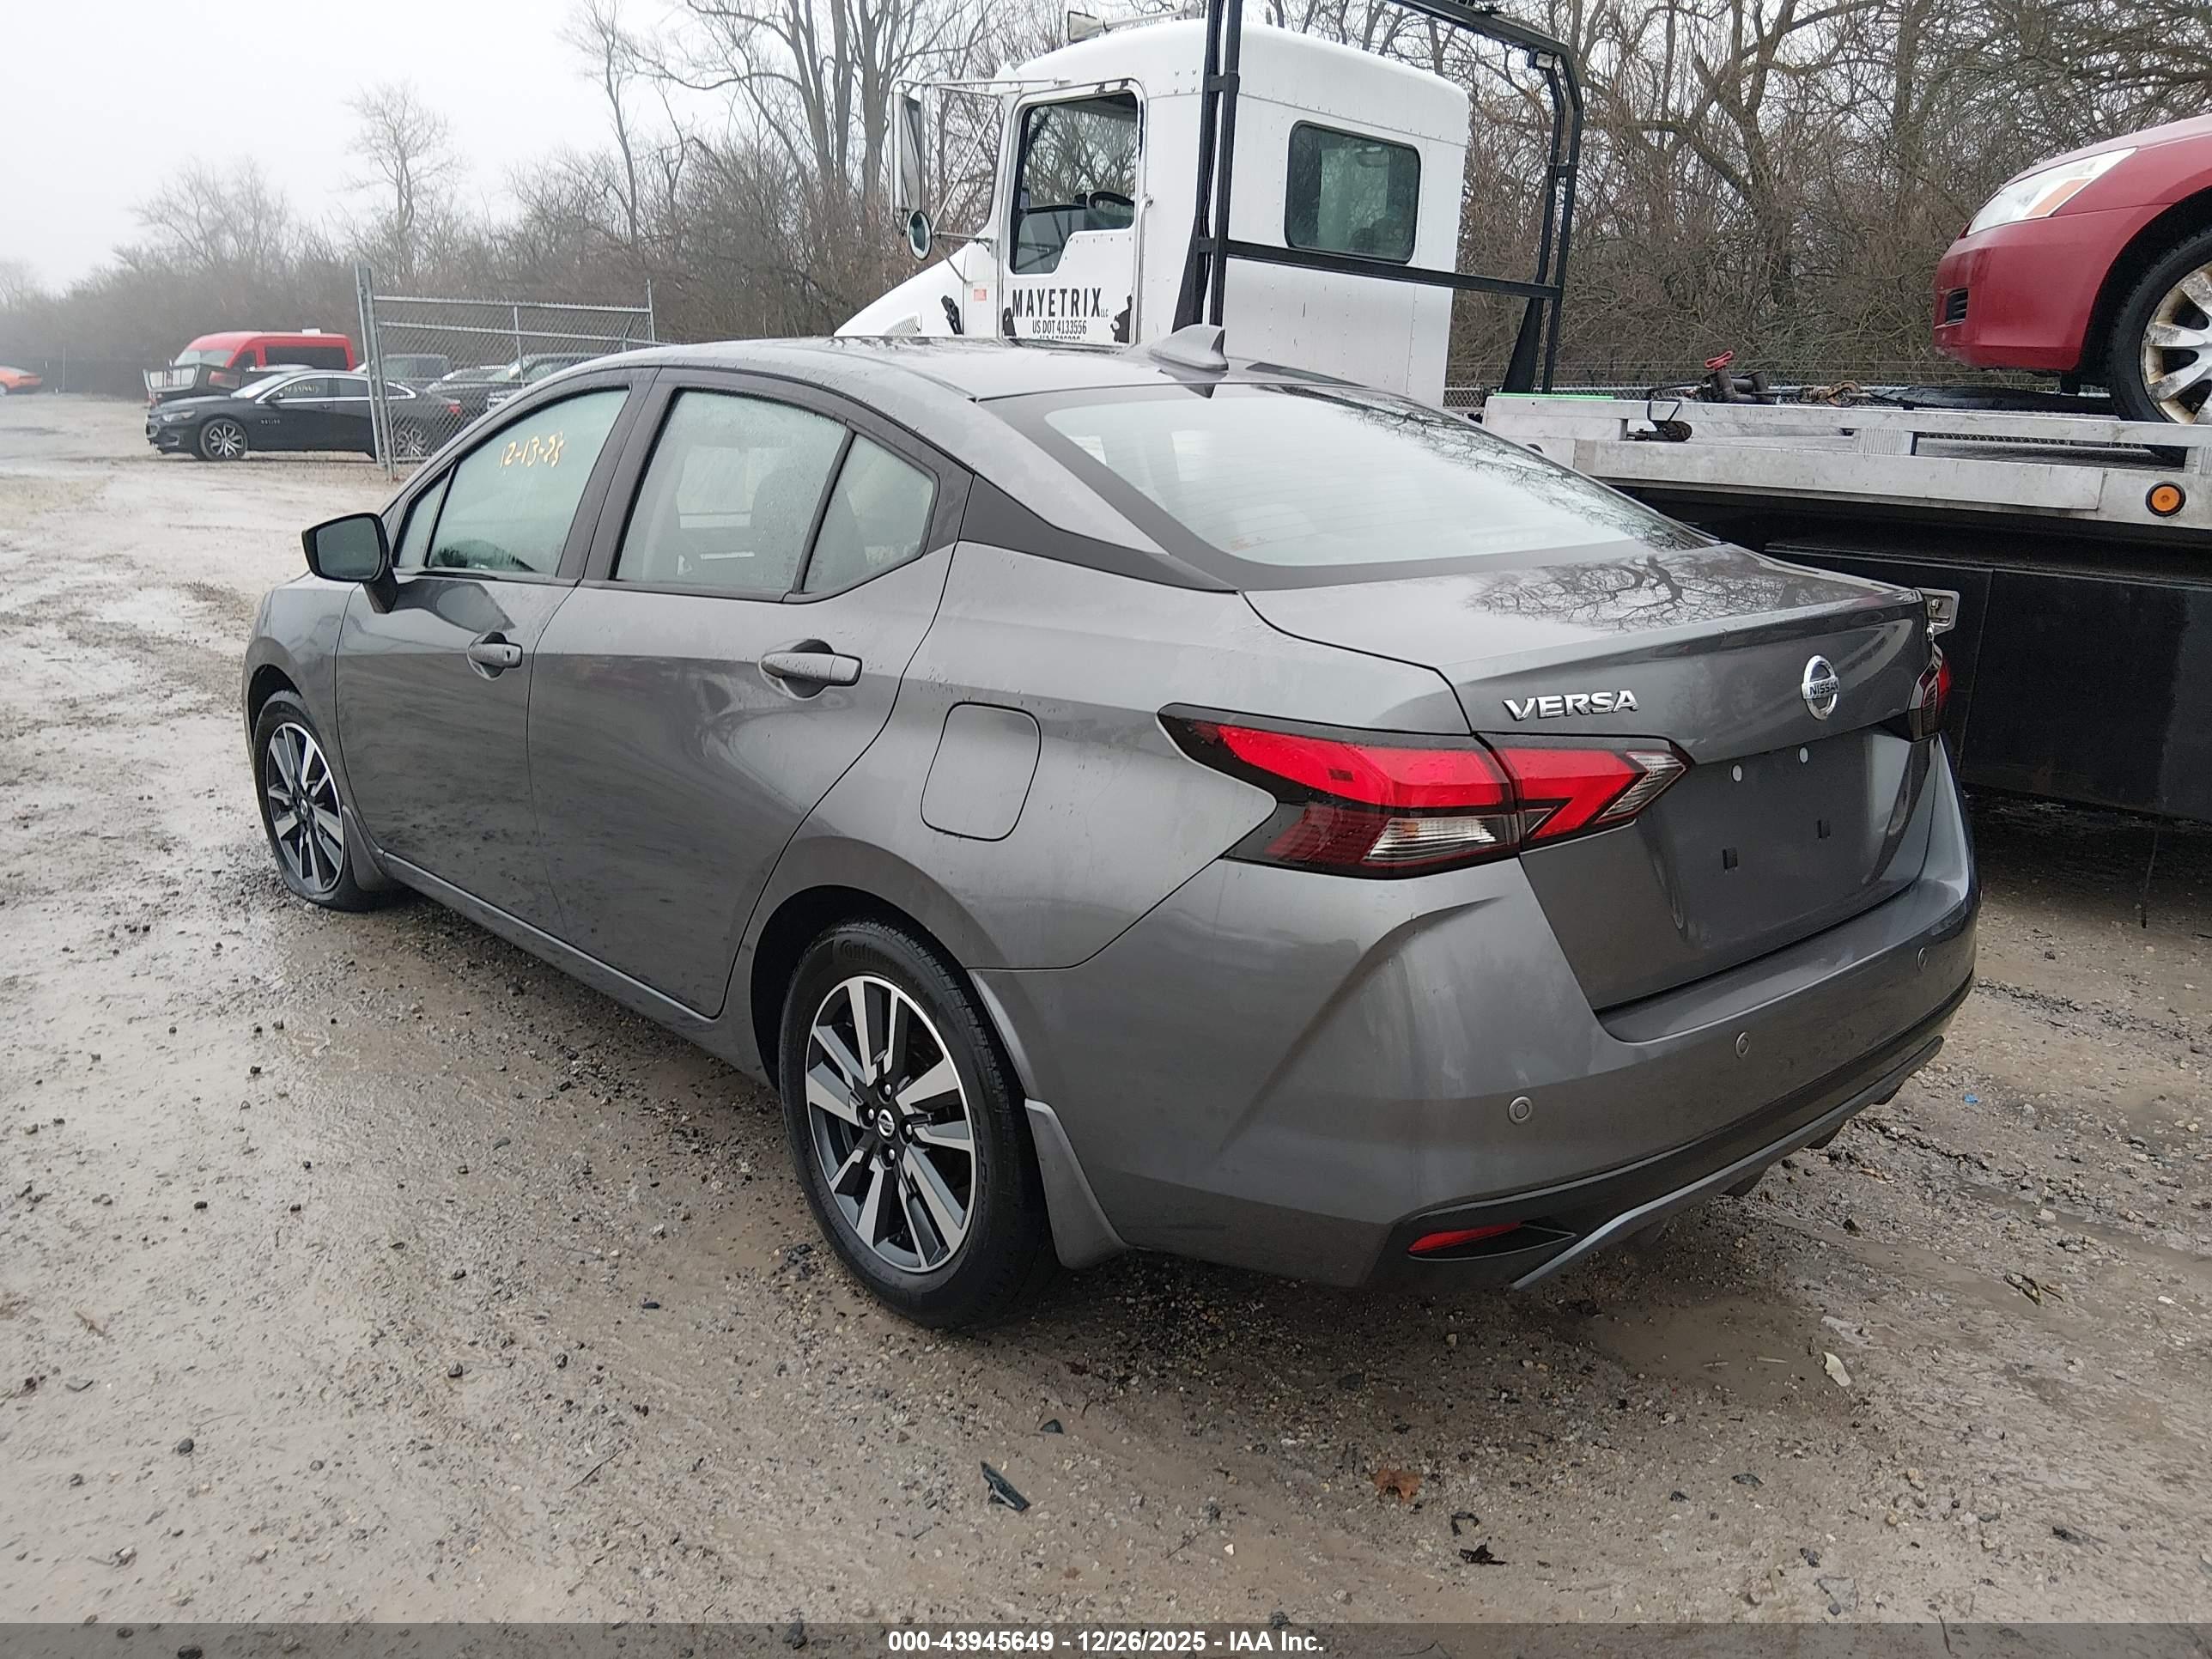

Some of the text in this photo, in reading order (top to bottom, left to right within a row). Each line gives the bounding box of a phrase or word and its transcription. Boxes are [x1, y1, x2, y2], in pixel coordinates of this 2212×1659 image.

[1012, 288, 1109, 318] MAYETRIX LLC
[1032, 319, 1087, 335] US DOT 4133556
[1809, 678, 1838, 696] NISSAN
[1503, 690, 1638, 720] VERSA
